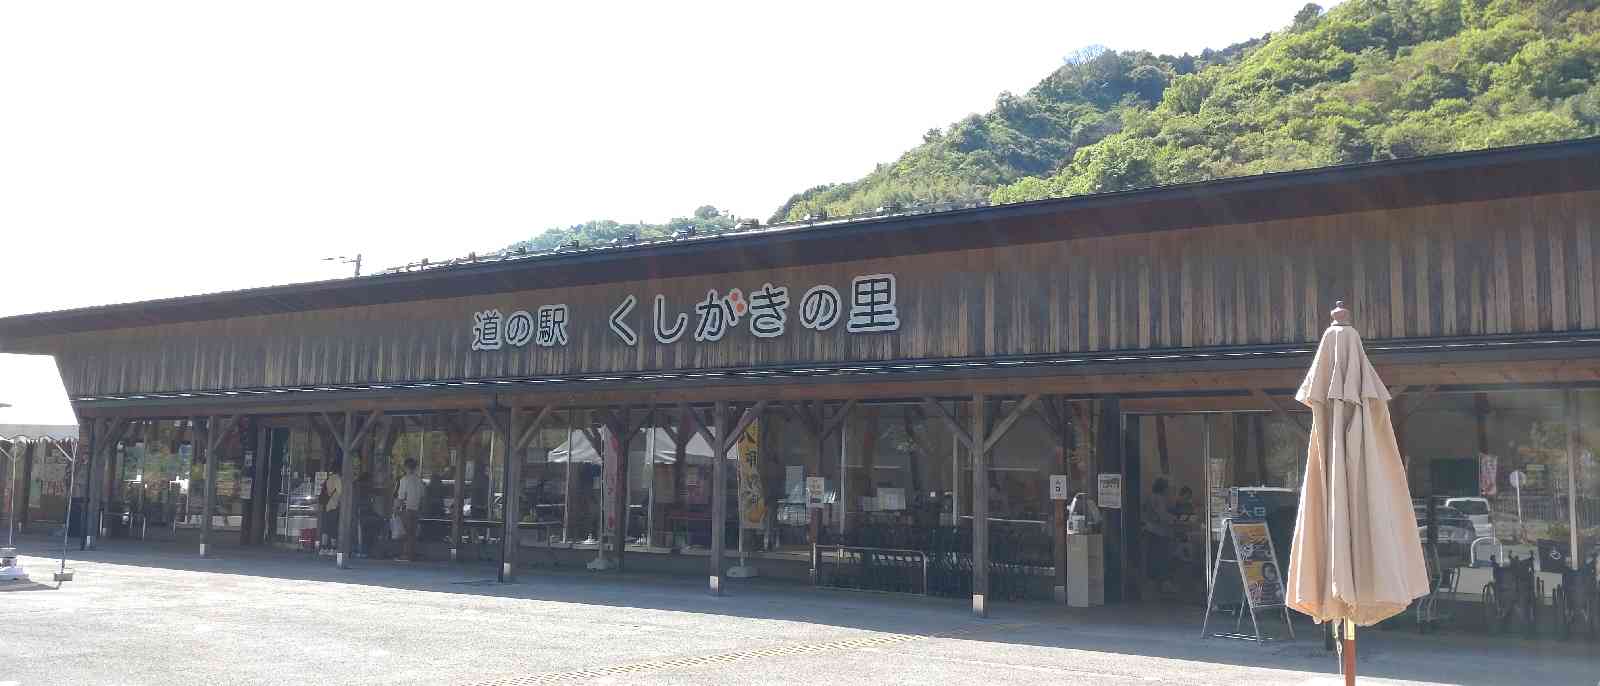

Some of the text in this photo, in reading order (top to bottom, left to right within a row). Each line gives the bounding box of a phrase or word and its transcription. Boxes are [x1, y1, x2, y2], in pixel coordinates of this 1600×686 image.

[473, 274, 900, 350] 道の駅 くしがきの里
